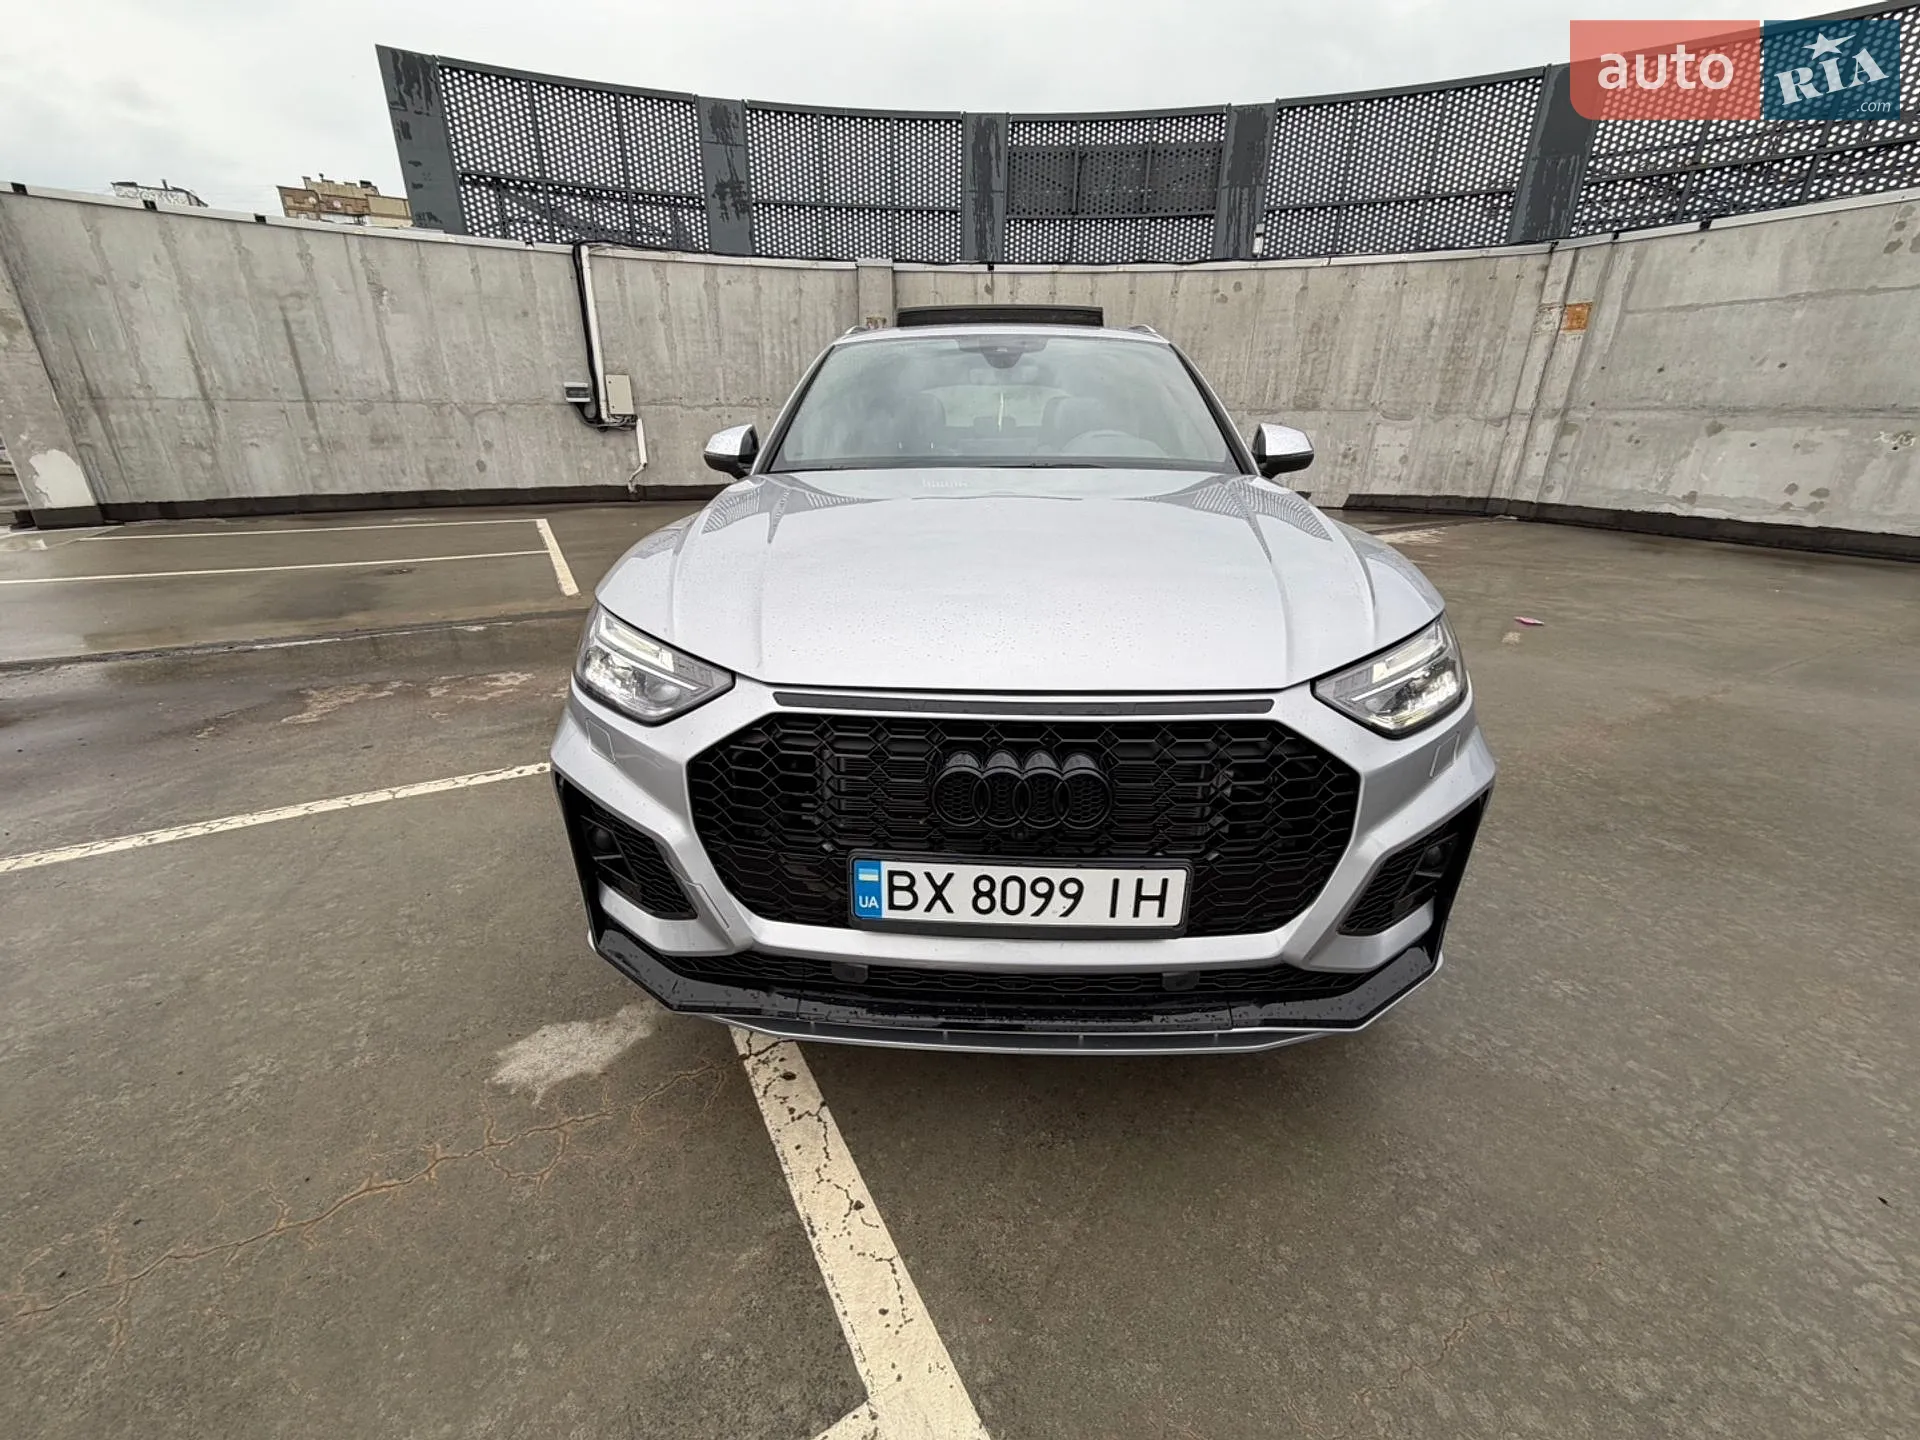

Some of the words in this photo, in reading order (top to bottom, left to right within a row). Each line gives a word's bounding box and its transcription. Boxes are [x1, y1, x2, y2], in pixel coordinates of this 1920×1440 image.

[858, 896, 879, 909] UA
[887, 870, 954, 914] BX
[971, 874, 1085, 917] 8099
[1109, 878, 1169, 919] IH
